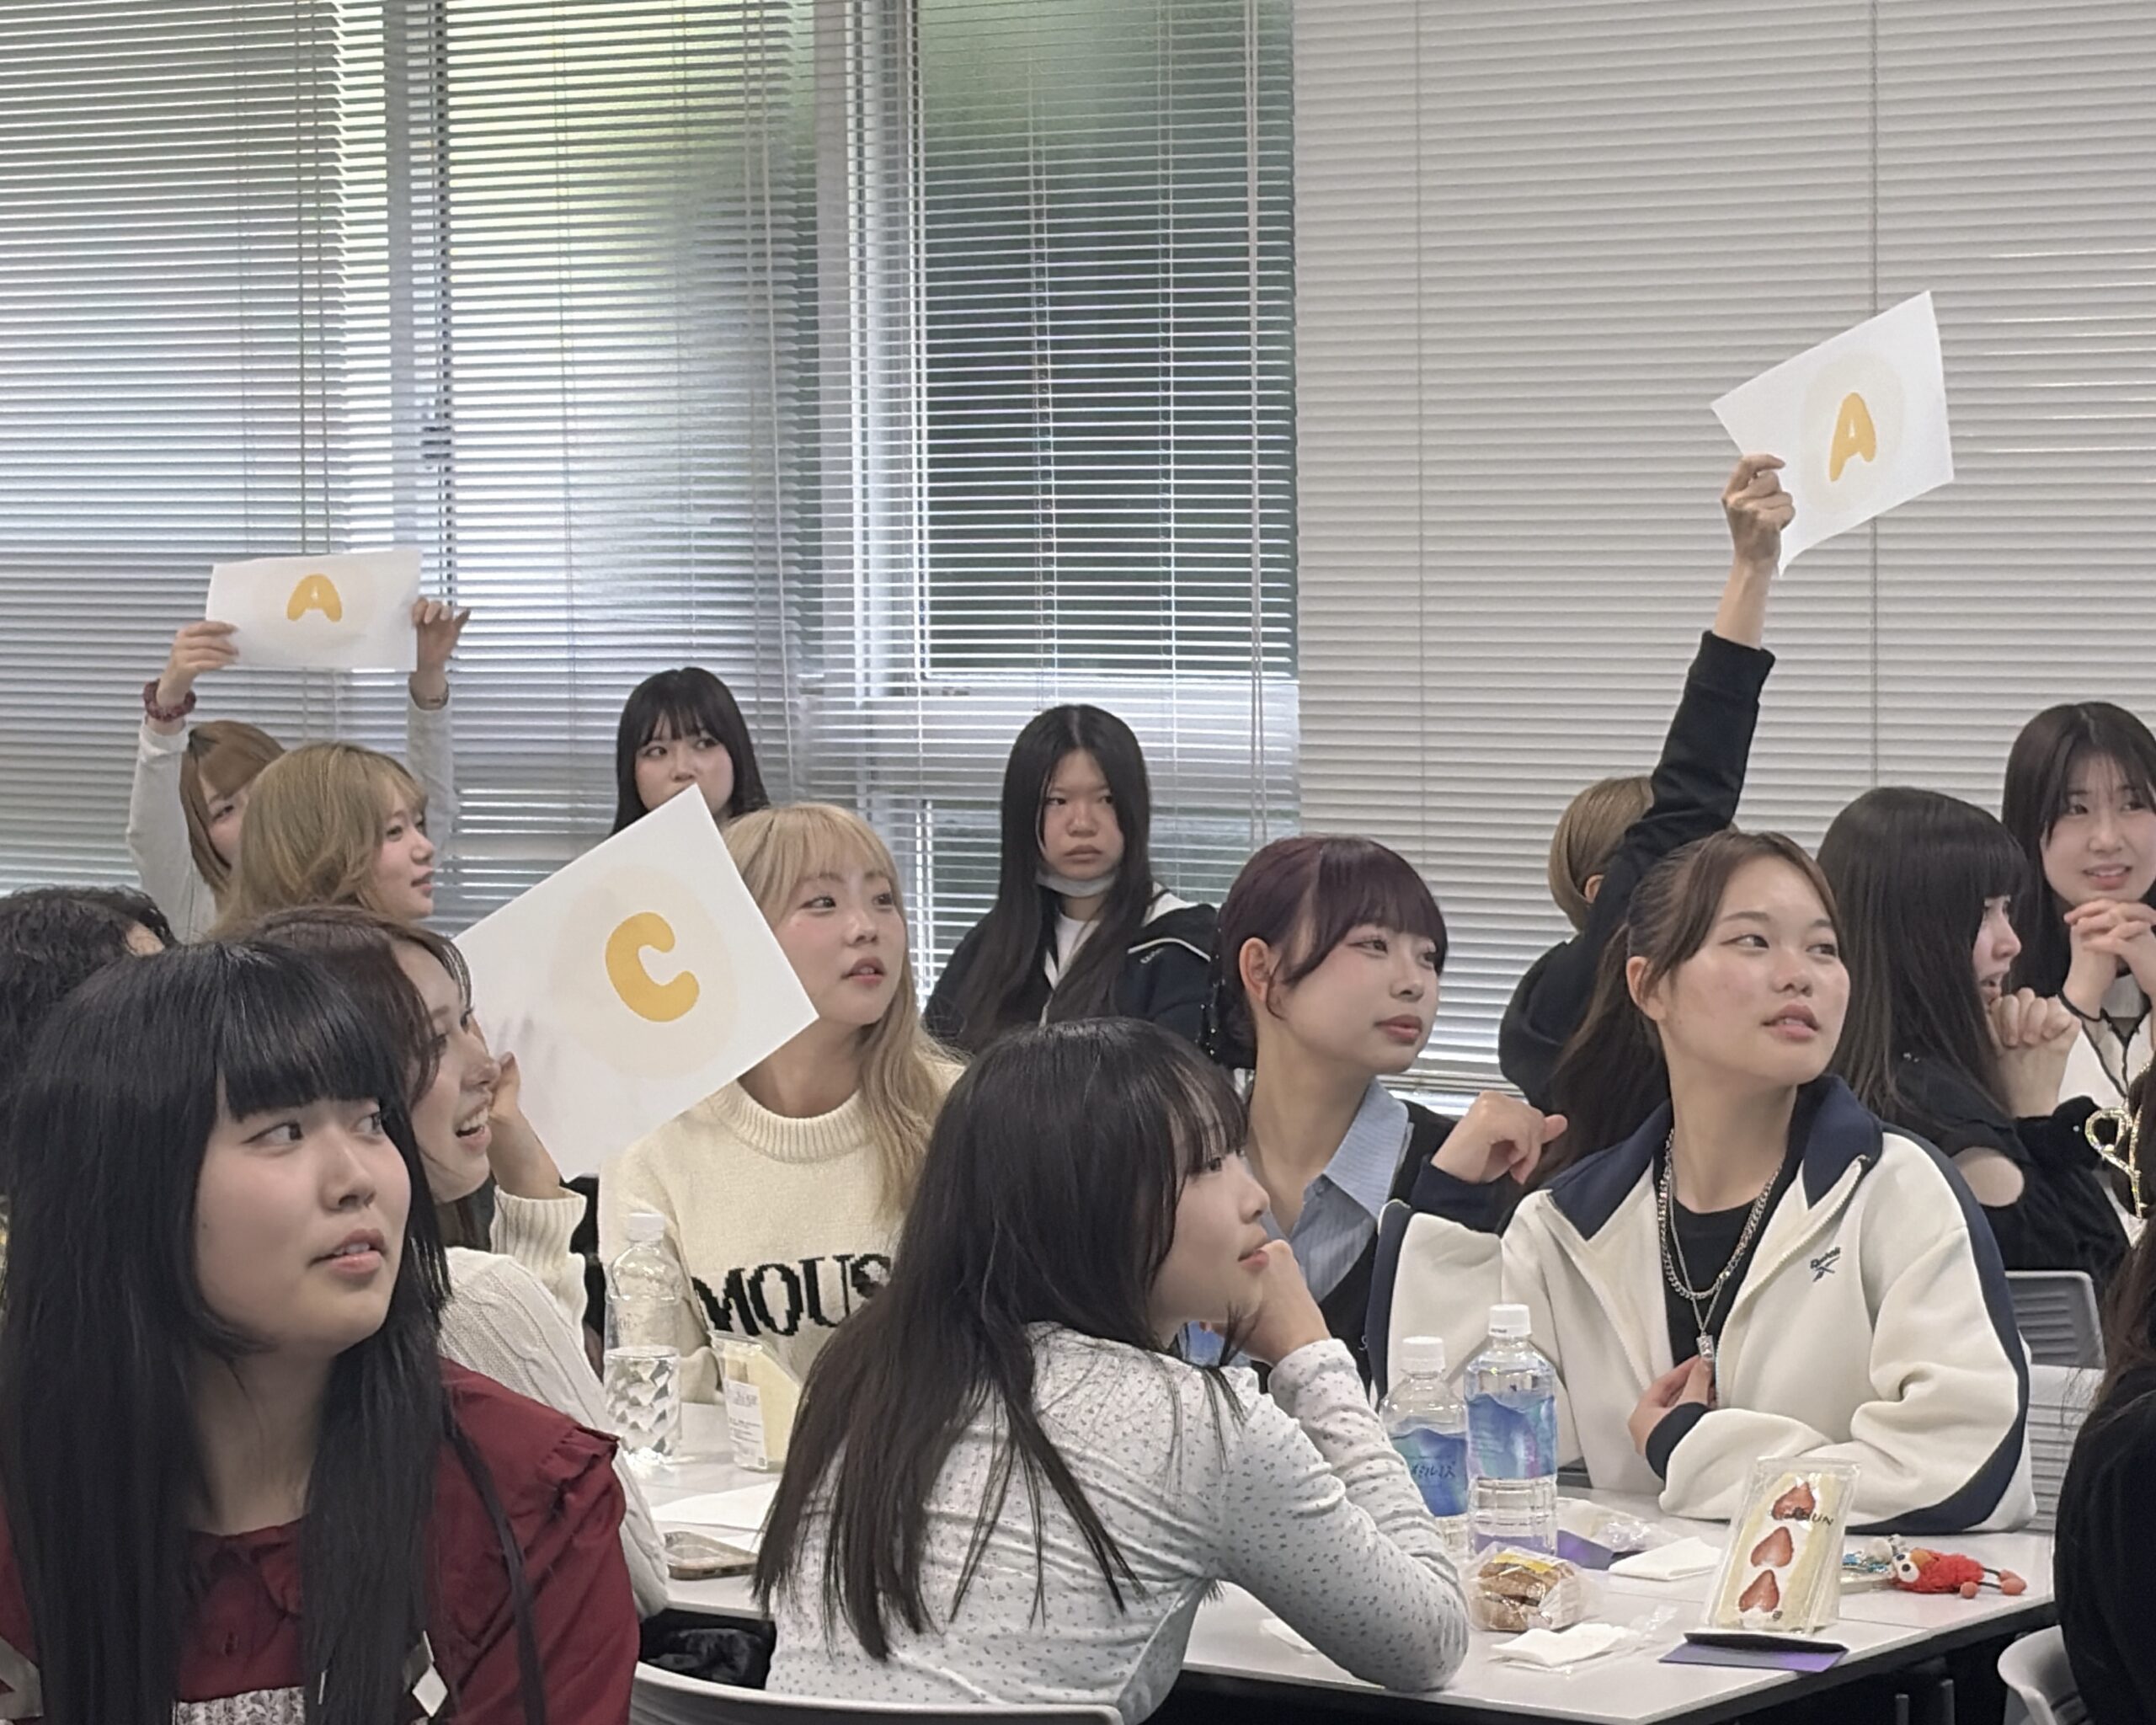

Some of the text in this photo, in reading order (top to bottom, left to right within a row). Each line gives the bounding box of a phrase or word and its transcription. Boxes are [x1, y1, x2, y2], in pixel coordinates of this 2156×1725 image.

[1829, 392, 1877, 483] A
[286, 575, 342, 622] A
[606, 912, 700, 1022] C
